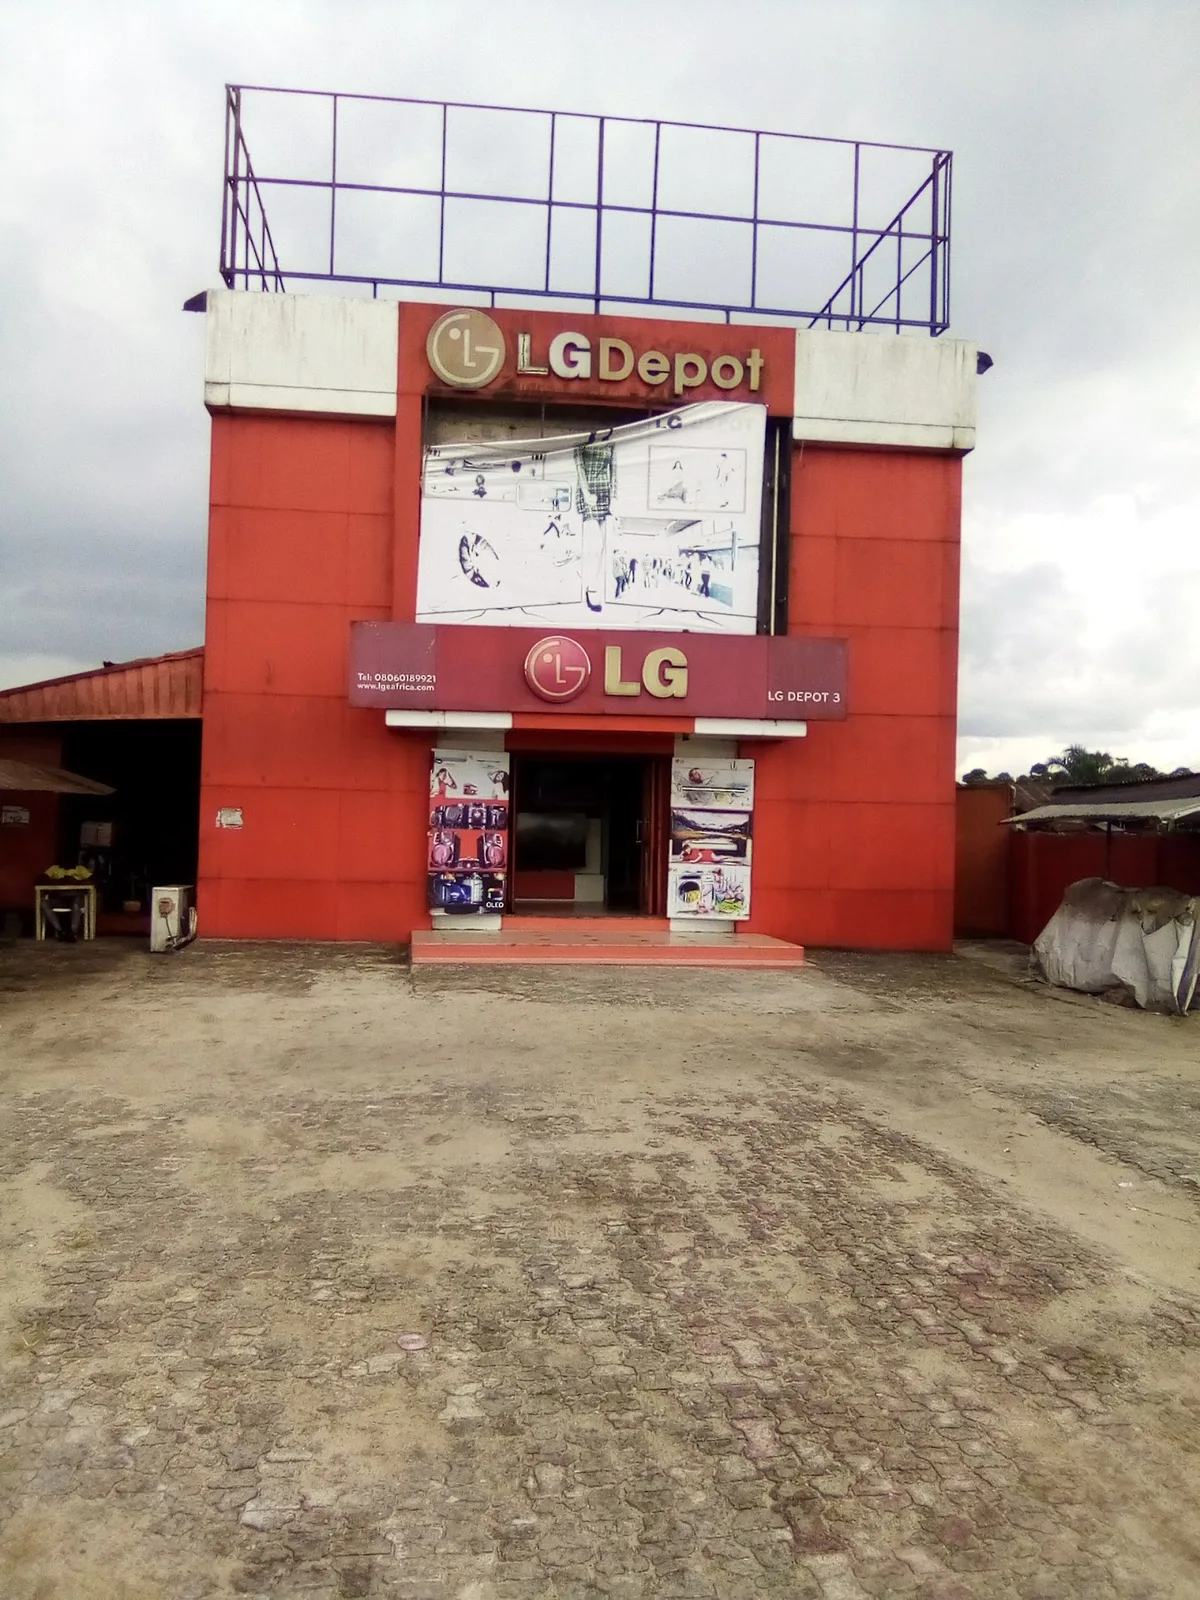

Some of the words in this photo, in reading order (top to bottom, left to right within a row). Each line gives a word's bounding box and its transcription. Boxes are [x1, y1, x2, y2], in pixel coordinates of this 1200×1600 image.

[357, 672, 372, 681] Tel:
[374, 673, 436, 683] 08060189921
[604, 645, 688, 698] LG
[357, 682, 435, 691] www.lgeafrica.com
[768, 690, 784, 701] LG
[787, 691, 829, 703] DEPOT
[833, 692, 840, 703] 3
